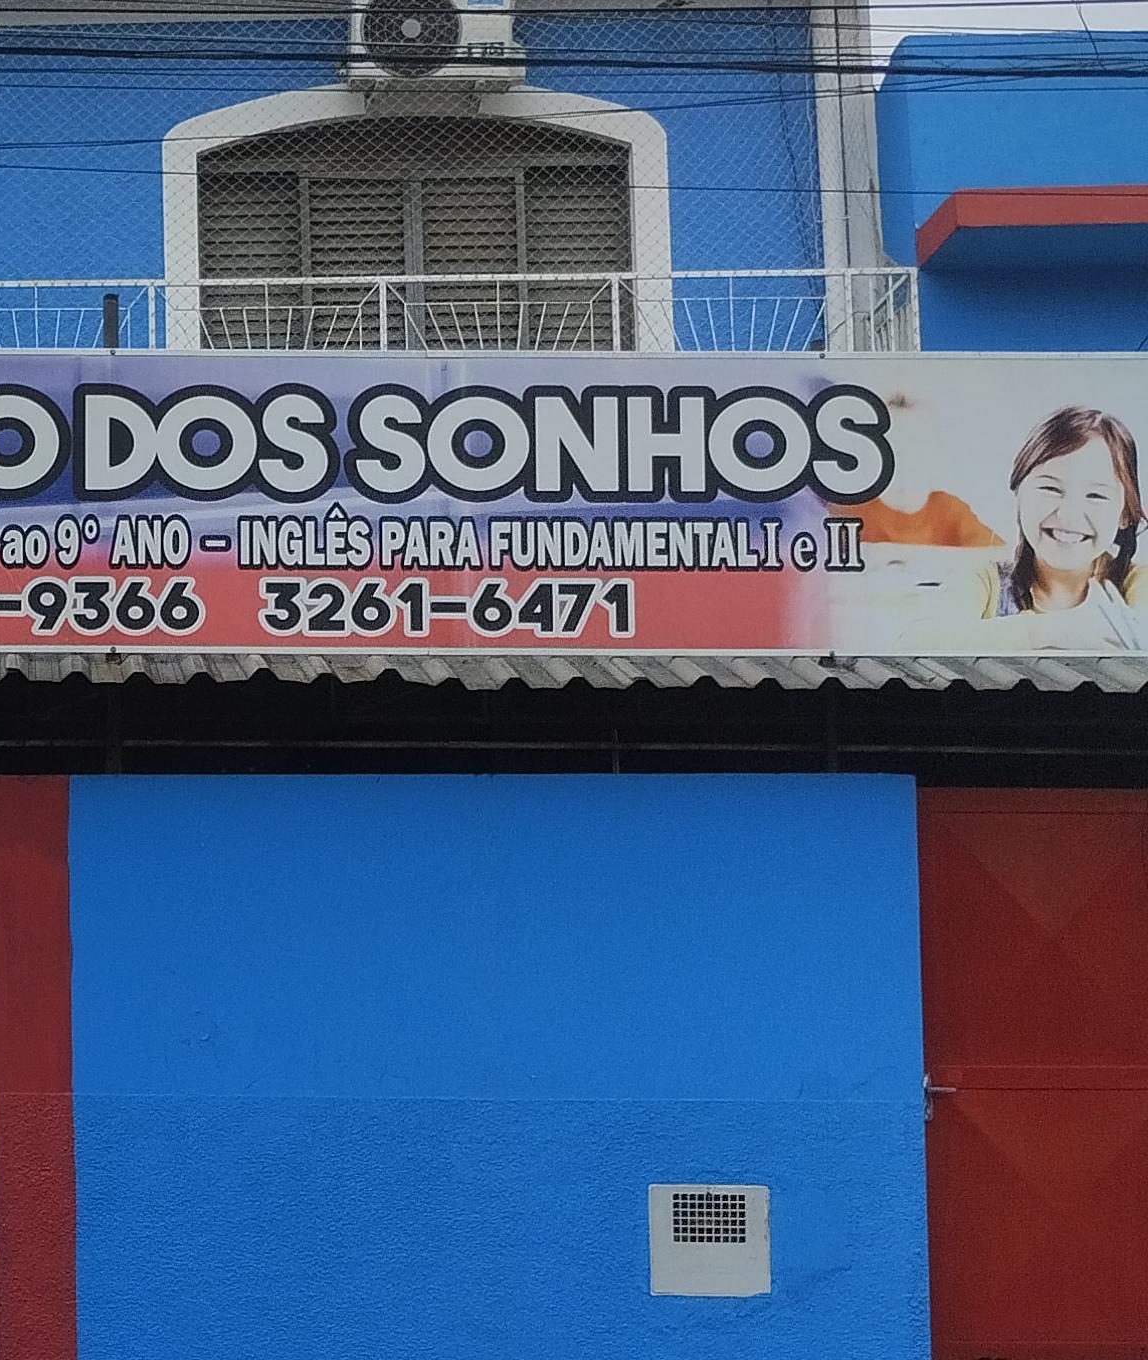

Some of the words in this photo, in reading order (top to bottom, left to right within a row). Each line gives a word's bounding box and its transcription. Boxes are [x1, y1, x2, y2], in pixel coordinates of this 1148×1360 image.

[85, 392, 329, 493] DOS
[356, 392, 883, 495] SONHOS
[2, 528, 47, 565] ao
[111, 518, 191, 566] ANO
[240, 505, 374, 567] INGLÊS
[382, 520, 473, 568] PARA
[490, 520, 757, 568] FUNDAMENTAL
[762, 522, 781, 568] I
[793, 534, 817, 568] e
[826, 521, 864, 569] II
[264, 581, 633, 634] 3261-6471
